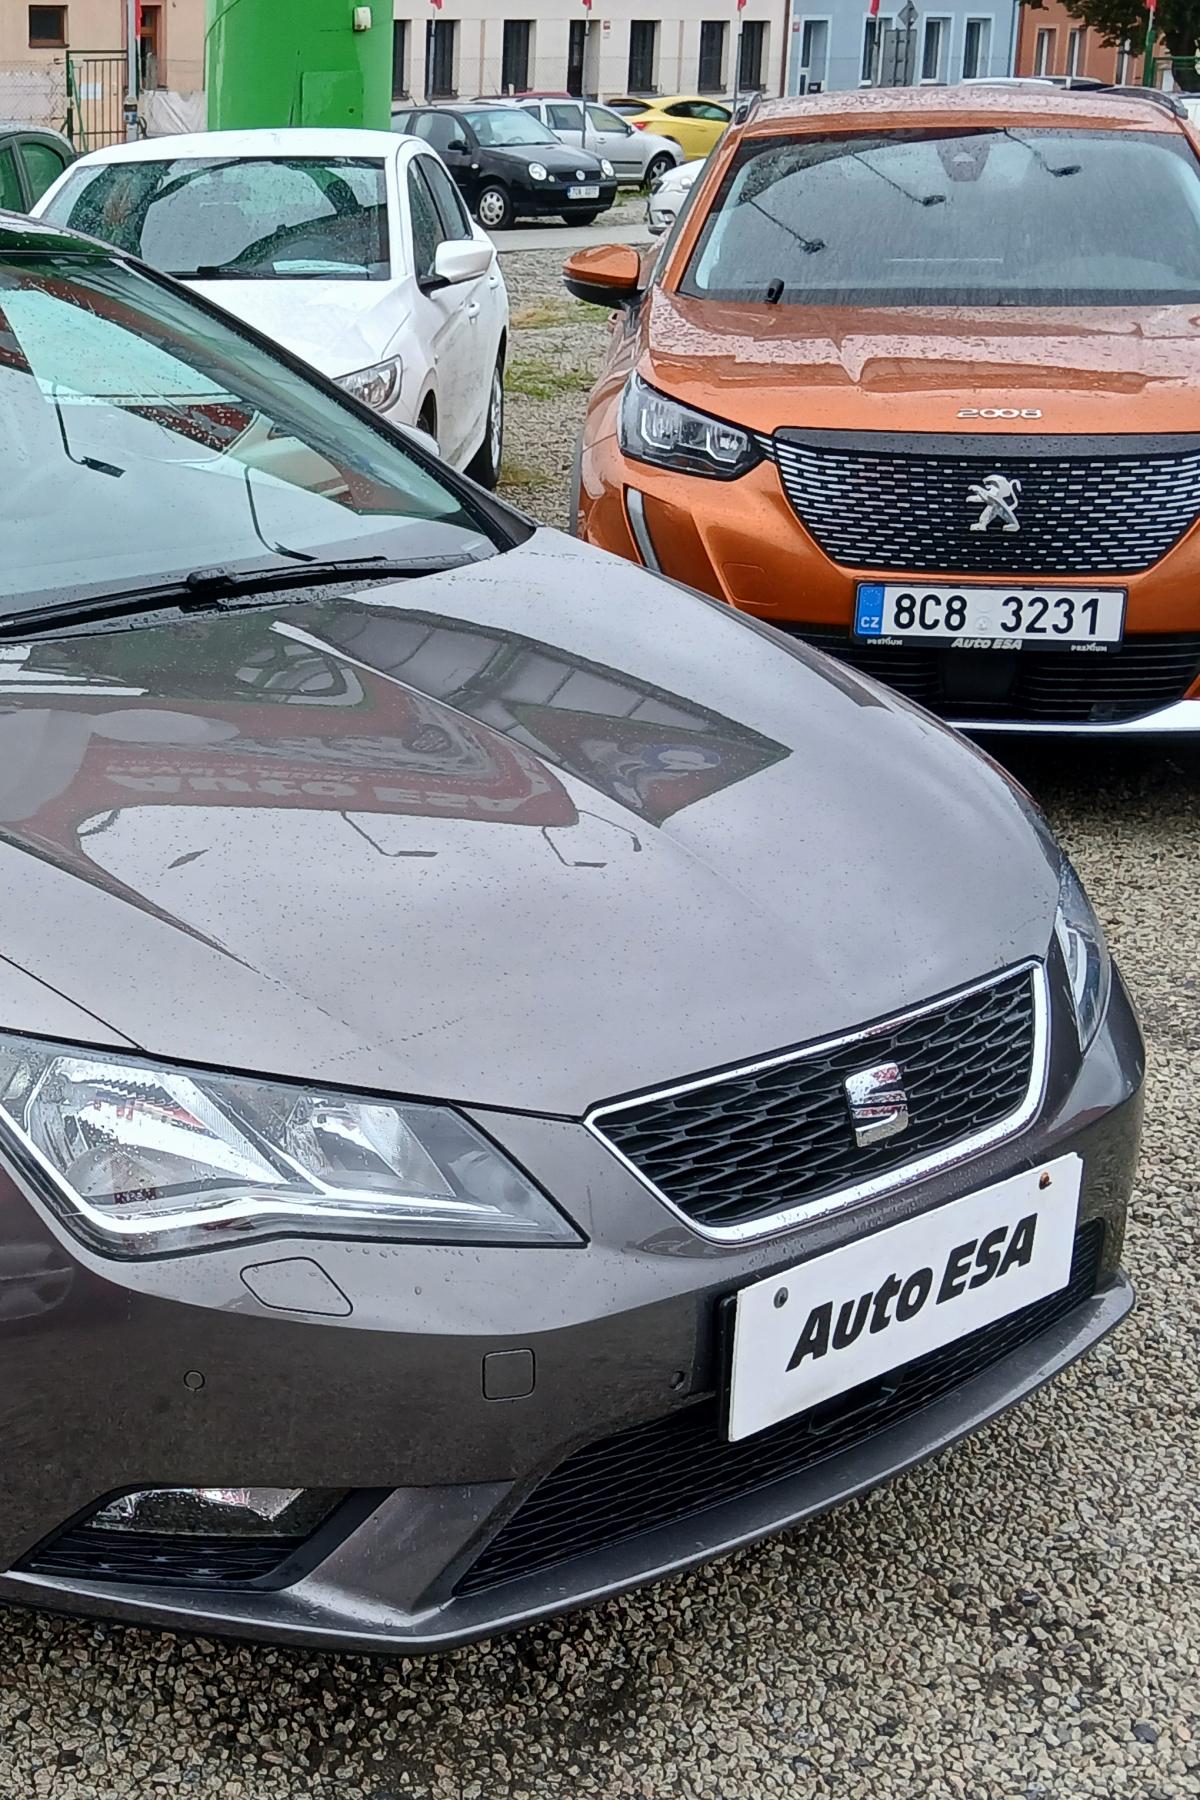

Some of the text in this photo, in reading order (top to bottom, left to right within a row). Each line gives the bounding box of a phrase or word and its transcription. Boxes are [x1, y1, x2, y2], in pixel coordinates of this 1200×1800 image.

[956, 408, 1043, 419] 2008
[893, 593, 1100, 635] 8C8 3231
[860, 616, 880, 628] CZ
[991, 638, 1023, 651] ESA
[935, 1212, 1038, 1306] ESA
